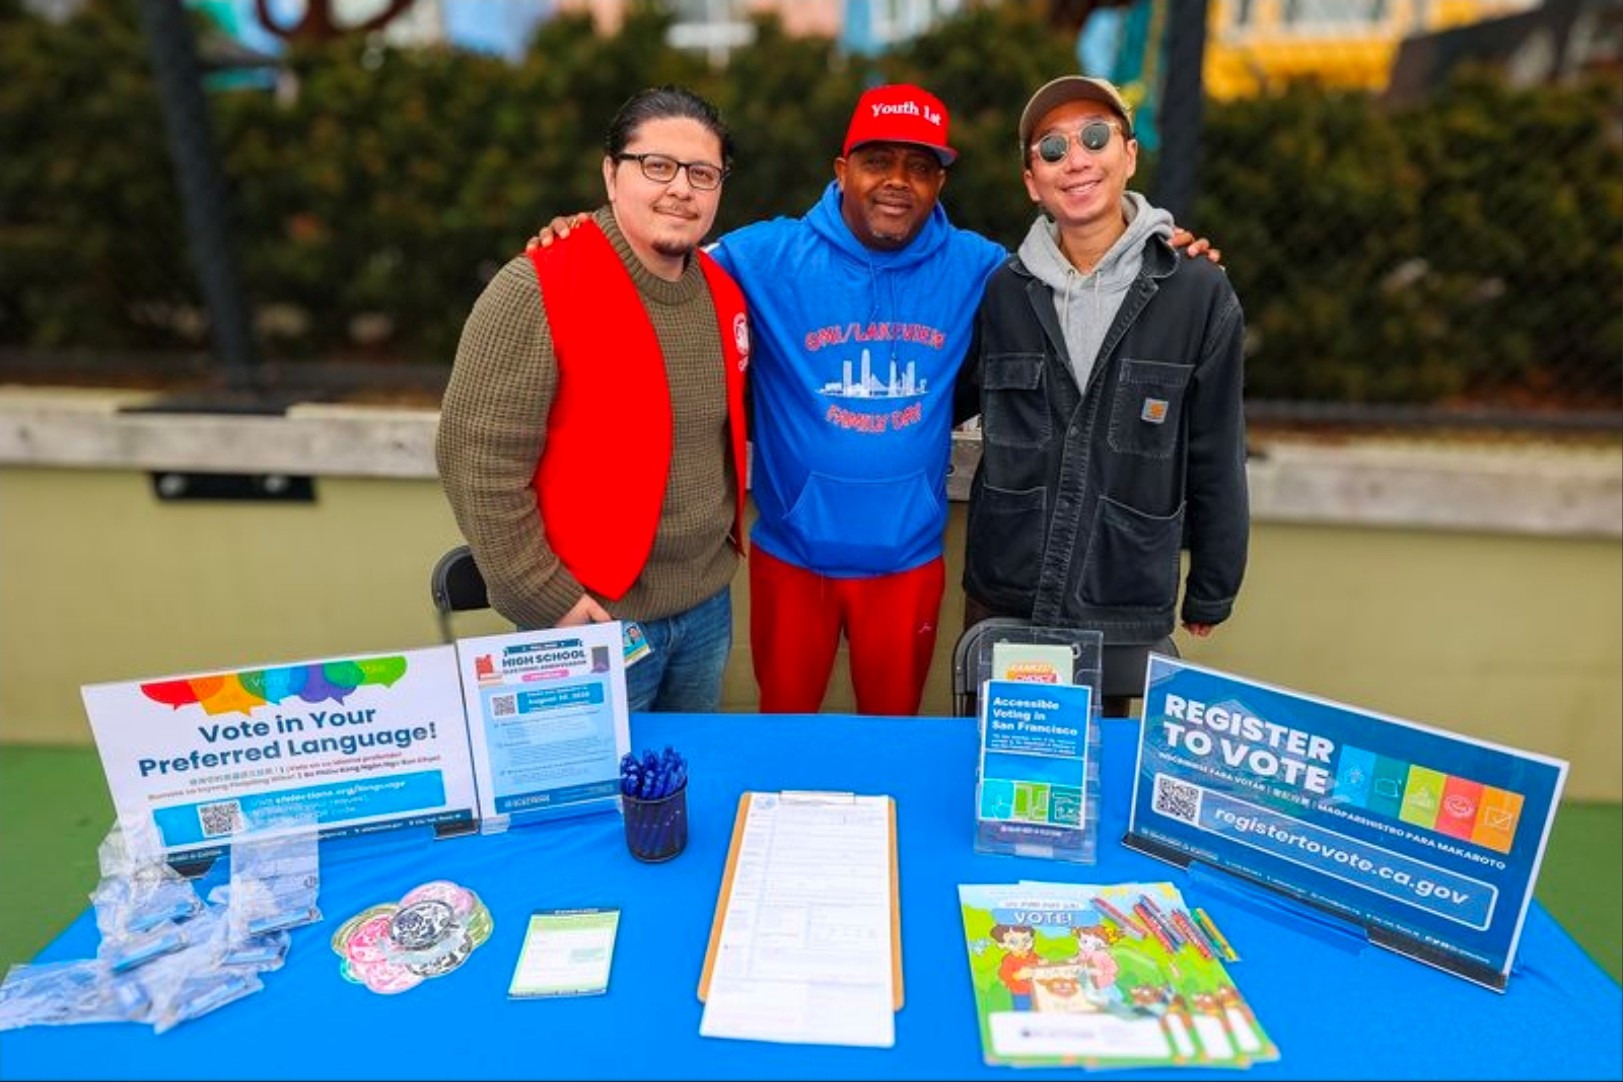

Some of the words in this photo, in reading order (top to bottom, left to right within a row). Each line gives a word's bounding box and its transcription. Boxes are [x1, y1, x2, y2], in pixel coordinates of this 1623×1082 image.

[871, 101, 919, 118] Youth
[923, 105, 941, 126] 1st
[826, 403, 886, 433] FAMILY
[891, 400, 922, 430] DAY
[502, 655, 534, 668] HIGH
[535, 650, 586, 664] SCHOOL
[993, 697, 1060, 710] Accessible
[993, 708, 1031, 722] Voting
[1034, 711, 1046, 721] in
[199, 721, 270, 744] Vote
[276, 714, 304, 734] in
[309, 707, 377, 730] Your
[992, 720, 1015, 731] San
[1018, 721, 1078, 737] Francisco
[1163, 693, 1335, 765] REGISTER
[138, 739, 282, 778] Preferred
[288, 721, 437, 758] Language!
[1162, 721, 1214, 756] TO
[1219, 743, 1332, 796] VOTE
[1214, 806, 1469, 906] registertovote.ca.gov
[1405, 831, 1436, 848] PARA
[1437, 842, 1507, 871] MAKABOTO
[1013, 911, 1072, 925] VOTE!
